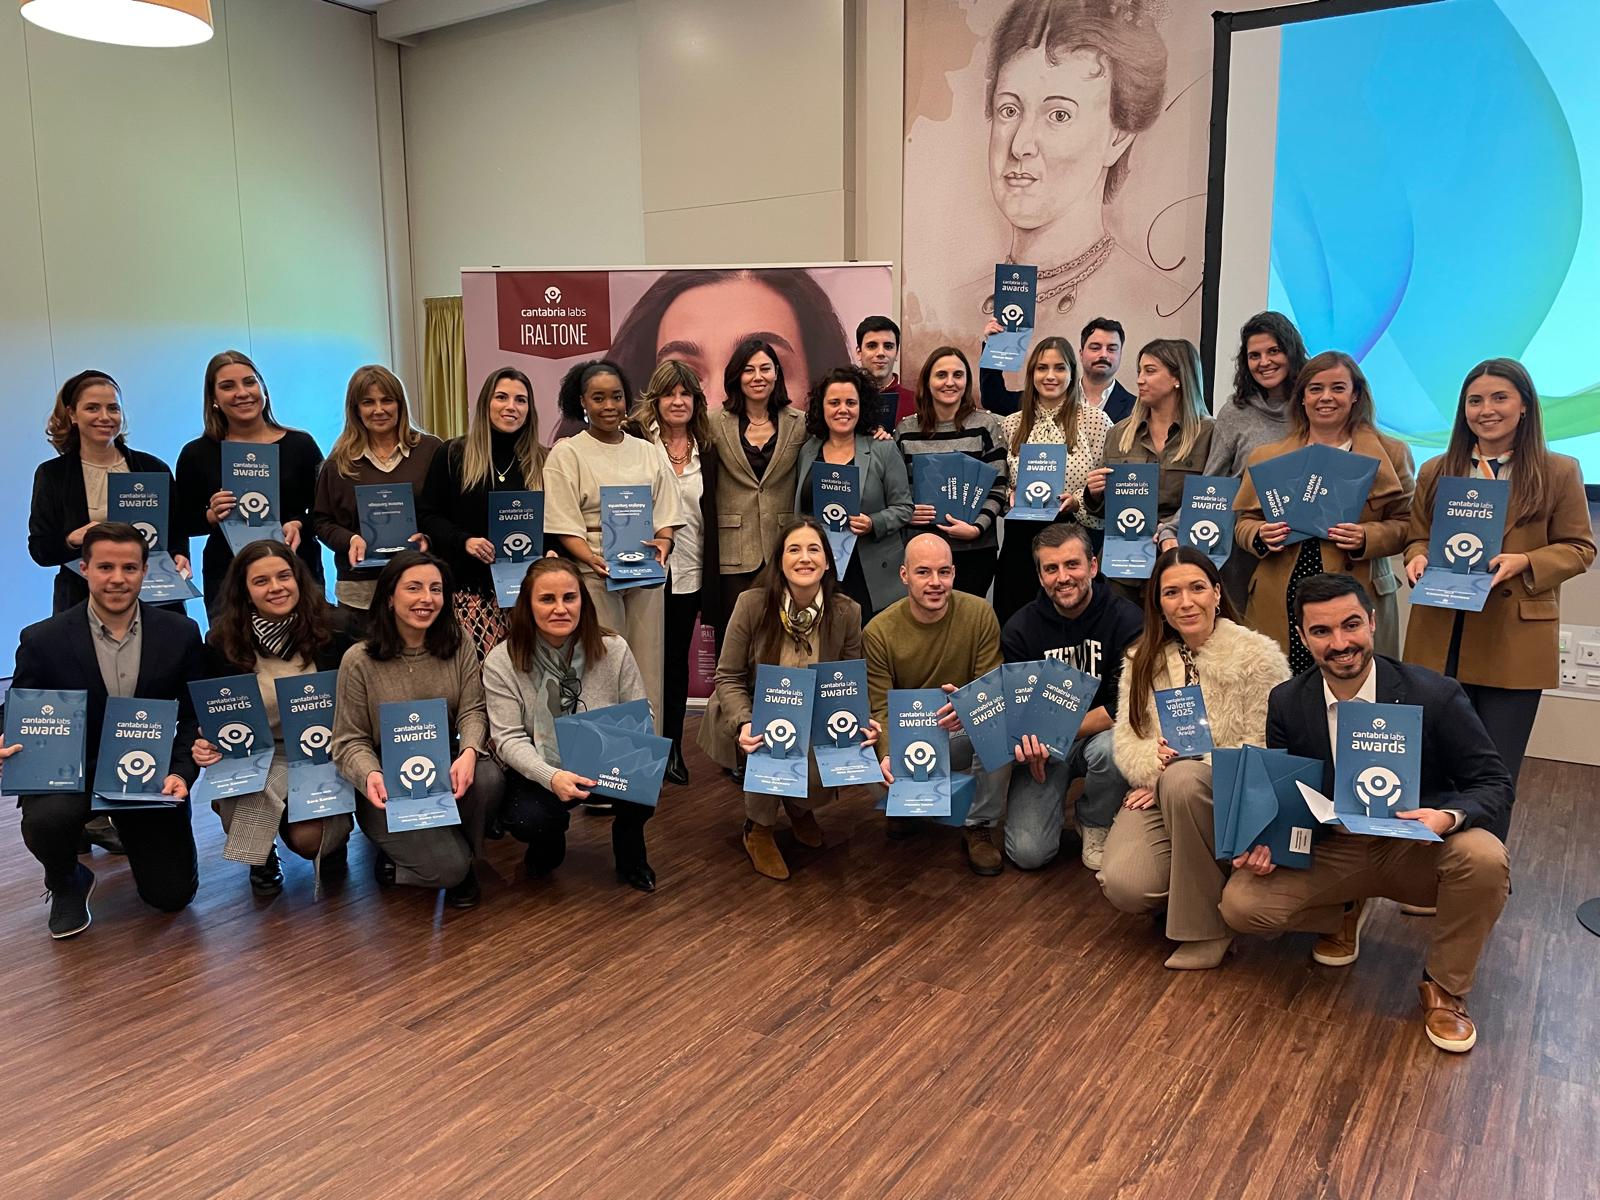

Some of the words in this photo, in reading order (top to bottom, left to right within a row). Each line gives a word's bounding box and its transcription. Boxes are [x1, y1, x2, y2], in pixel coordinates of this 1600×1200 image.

[521, 307, 566, 317] cantabria
[568, 307, 586, 317] labs
[521, 324, 588, 345] IRALTONE
[233, 468, 270, 477] awards
[821, 483, 852, 492] awards
[1115, 487, 1149, 496] awards
[1302, 474, 1317, 502] awards
[119, 499, 158, 508] awards
[1191, 501, 1228, 511] awards
[1266, 490, 1280, 517] awards
[1447, 507, 1493, 519] awards
[820, 686, 858, 698] awards
[1046, 683, 1069, 698] cantabria
[206, 697, 236, 705] cantabria
[290, 695, 318, 704] cantabria
[291, 699, 332, 712] awards
[765, 694, 803, 706] awards
[1042, 690, 1078, 712] awards
[1166, 700, 1196, 710] valores
[208, 701, 252, 714] awards
[969, 701, 993, 717] cantabria
[1172, 708, 1194, 717] 2025
[394, 724, 423, 733] cantabria
[899, 718, 937, 727] awards
[20, 724, 70, 736] awards
[115, 729, 162, 739] awards
[394, 730, 437, 742] awards
[1352, 740, 1406, 754] awards
[597, 779, 628, 791] awards
